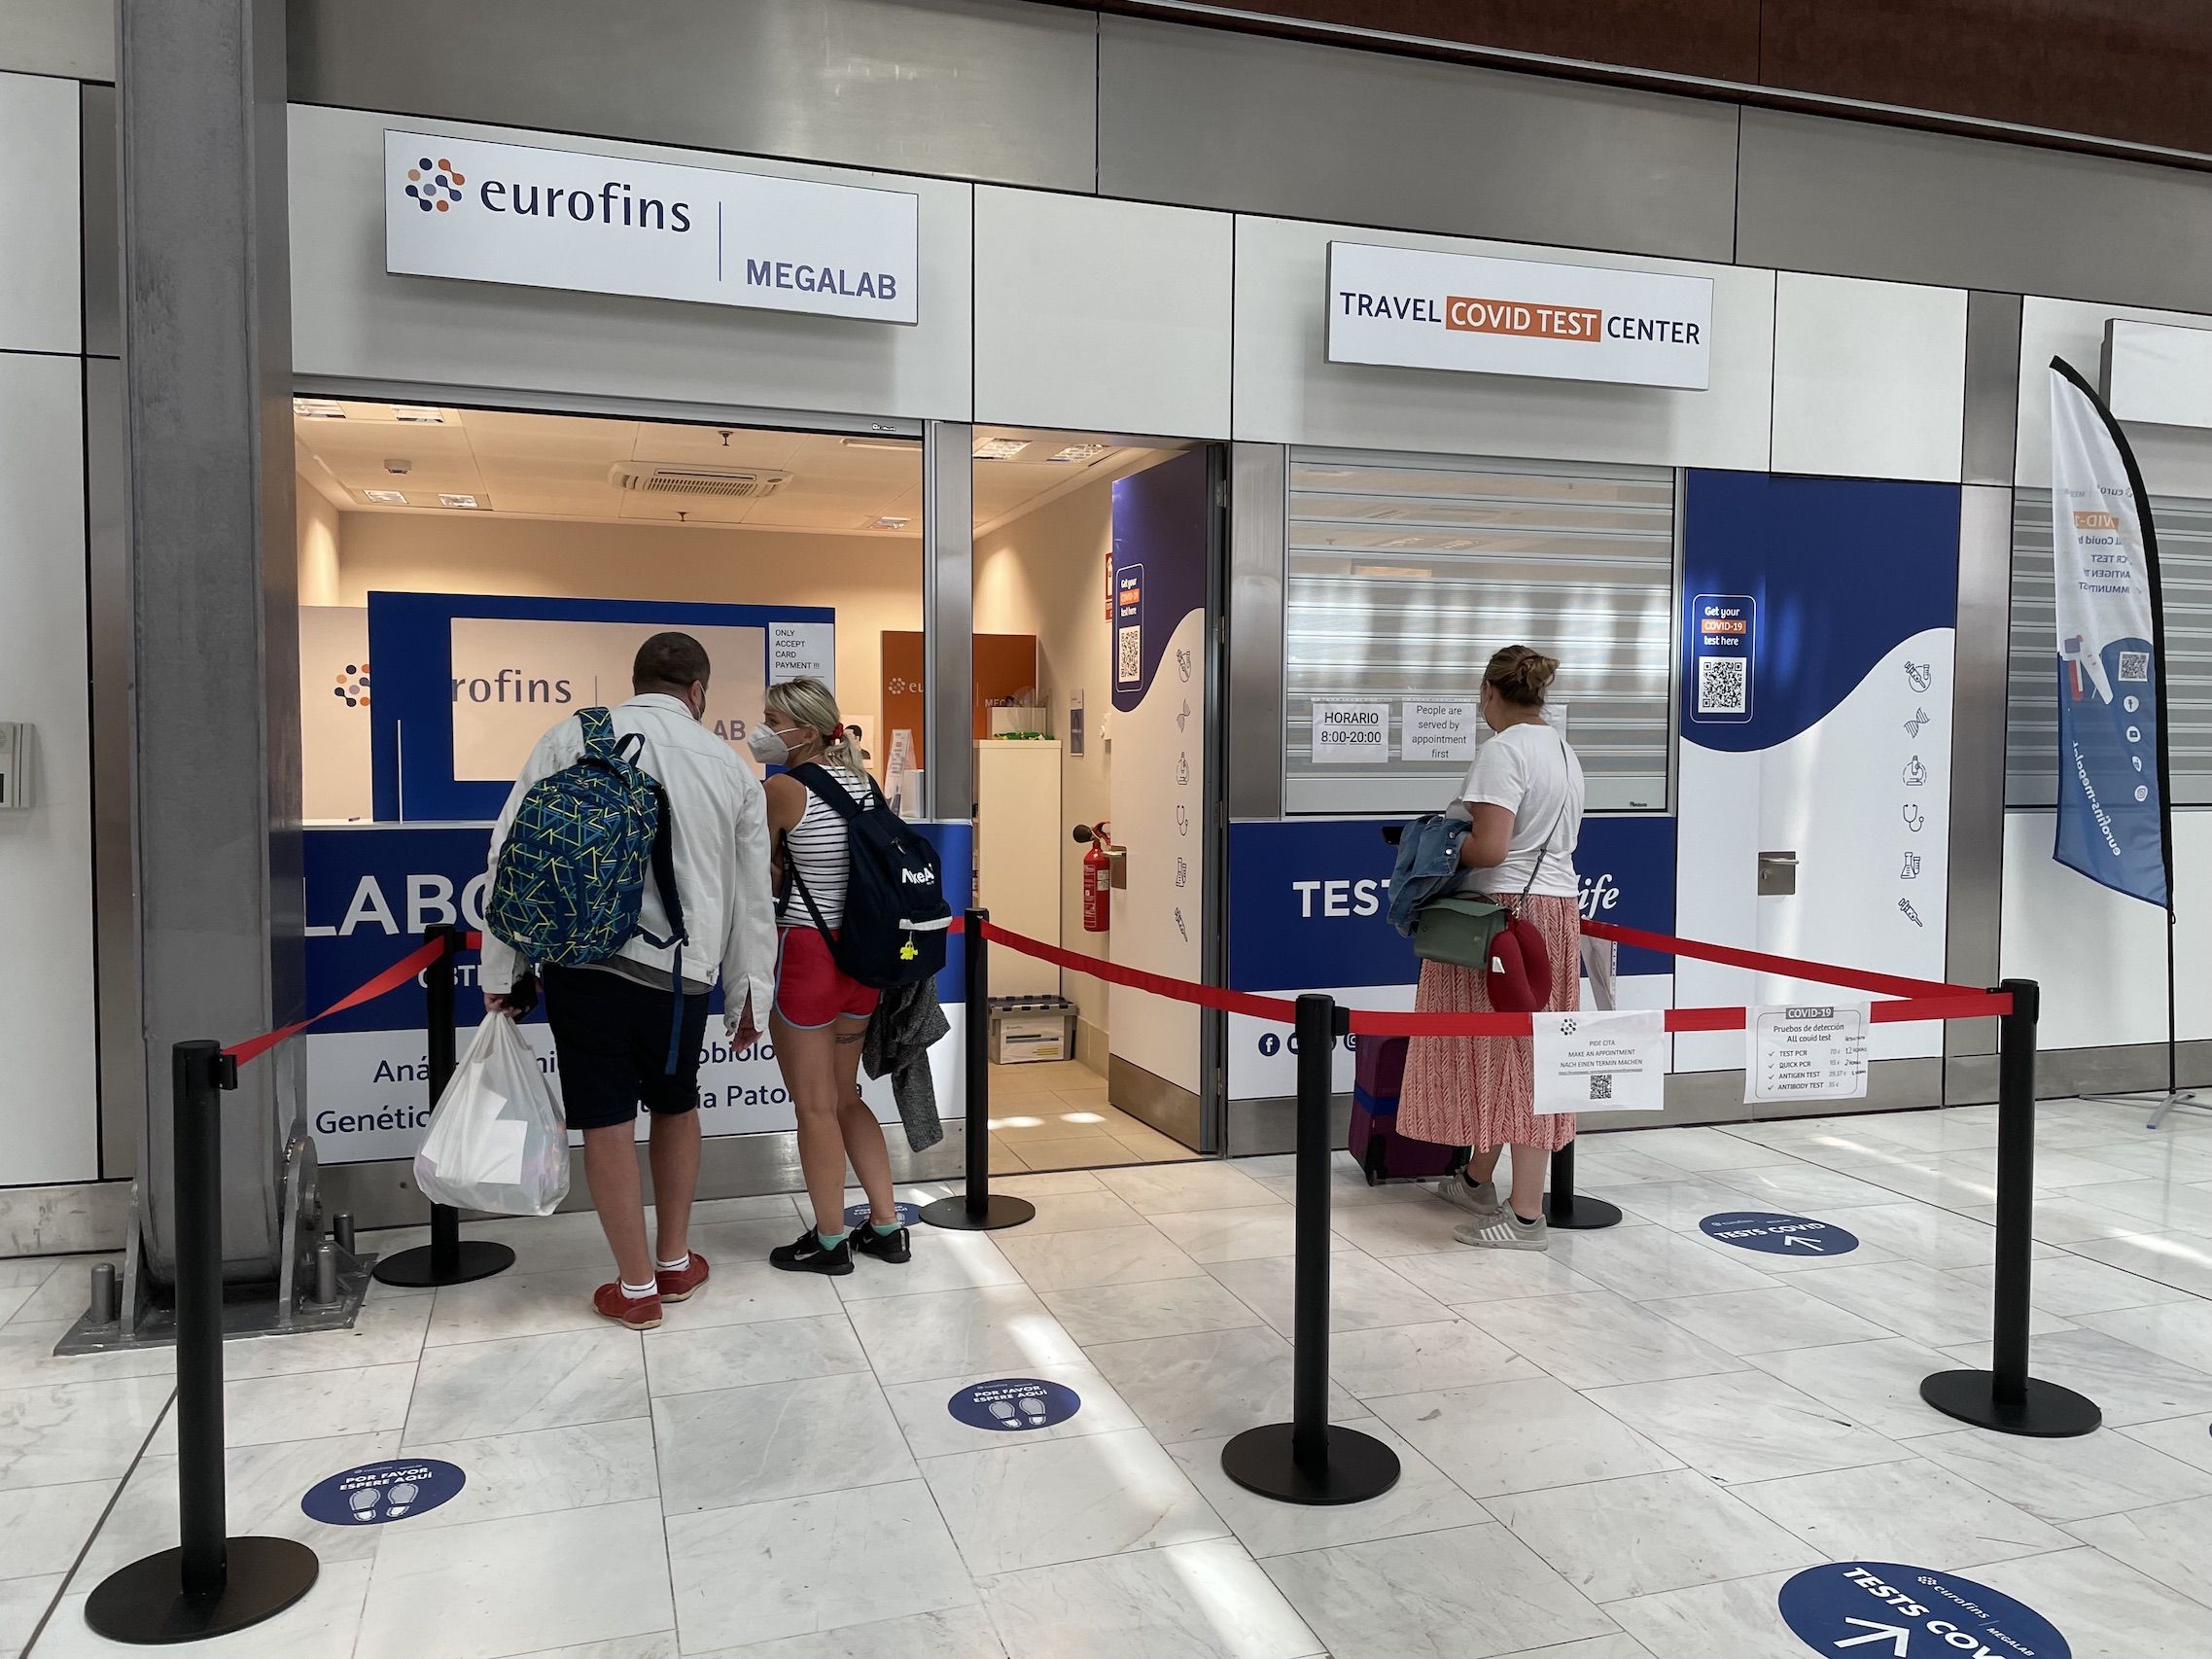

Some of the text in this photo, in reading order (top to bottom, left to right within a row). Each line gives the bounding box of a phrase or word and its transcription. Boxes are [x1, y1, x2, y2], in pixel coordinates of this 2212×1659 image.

[480, 179, 691, 232] eurofins
[747, 259, 897, 300] MEGALAB
[1340, 292, 1701, 345] TRAVEL COVID TEST CENTER
[1704, 607, 1739, 618] Get your
[1704, 621, 1742, 631] COVID-19
[1703, 635, 1738, 646] test here
[1416, 705, 1462, 717] People are
[1324, 712, 1379, 724] HORARIO
[1418, 720, 1459, 731] served by
[1320, 731, 1382, 744] 8:00-20:00
[1412, 734, 1466, 747] appointment
[1431, 749, 1449, 759] first
[1788, 1007, 1832, 1018] COVID-19
[1813, 1022, 1844, 1032] detección
[1713, 1222, 1826, 1239] TESTS COVID
[1002, 1385, 1041, 1395] FAVOR
[973, 1394, 1014, 1403] ESPERE
[345, 1474, 376, 1484] POR
[381, 1467, 429, 1478] FAVOR
[339, 1478, 391, 1491] ESPERE
[1933, 1584, 1990, 1620] eurofins
[1843, 1567, 2006, 1659] TESTS COV
[1986, 1627, 2035, 1658] MEGALAB
